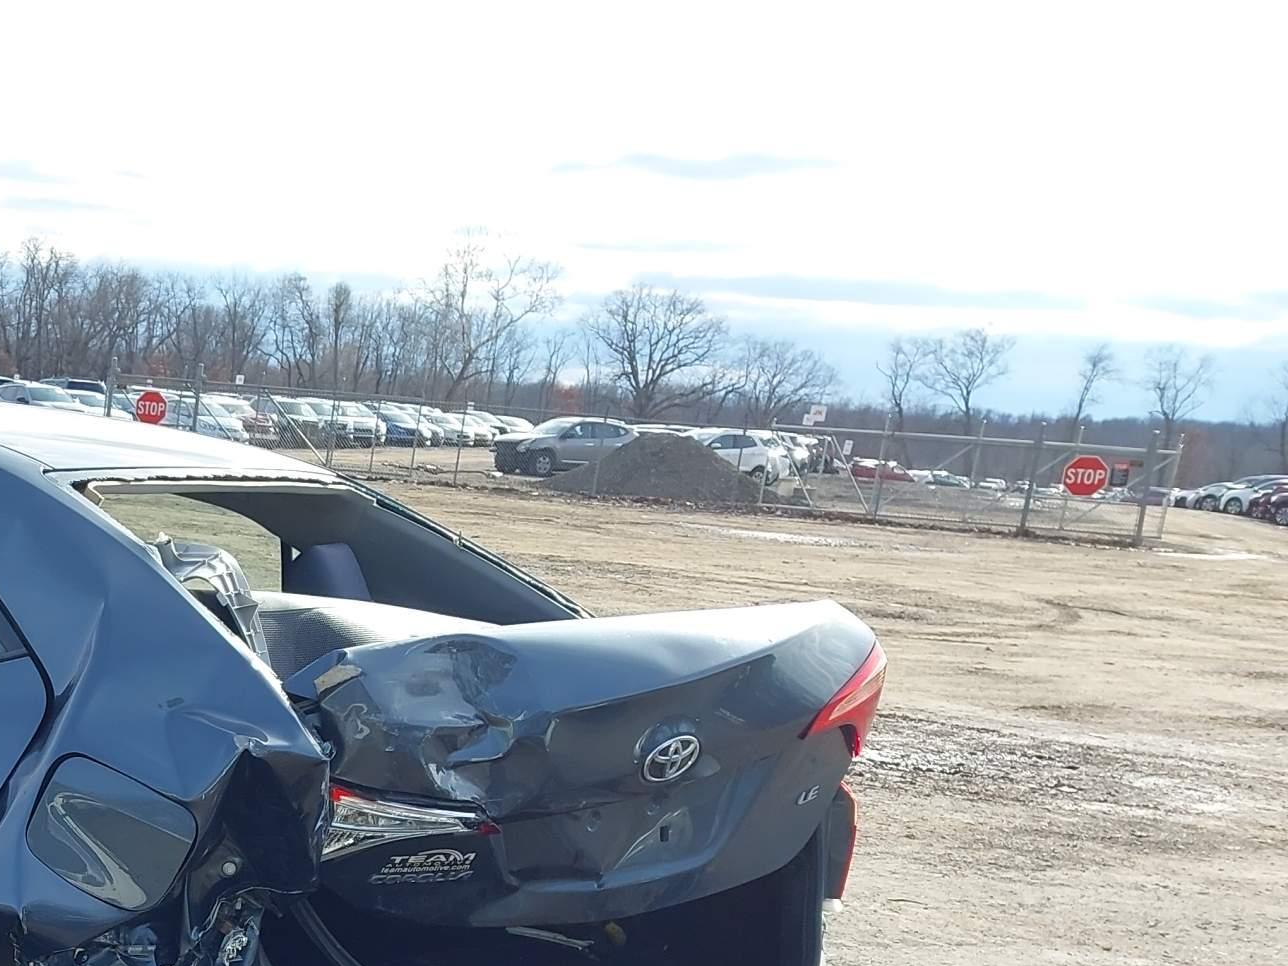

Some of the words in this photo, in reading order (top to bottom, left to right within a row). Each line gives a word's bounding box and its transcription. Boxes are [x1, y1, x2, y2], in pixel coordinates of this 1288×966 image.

[137, 400, 165, 416] STOP
[1065, 468, 1106, 485] STOP
[797, 785, 820, 805] LE
[390, 850, 476, 864] TEAM
[380, 864, 471, 874] teamautomotive.com
